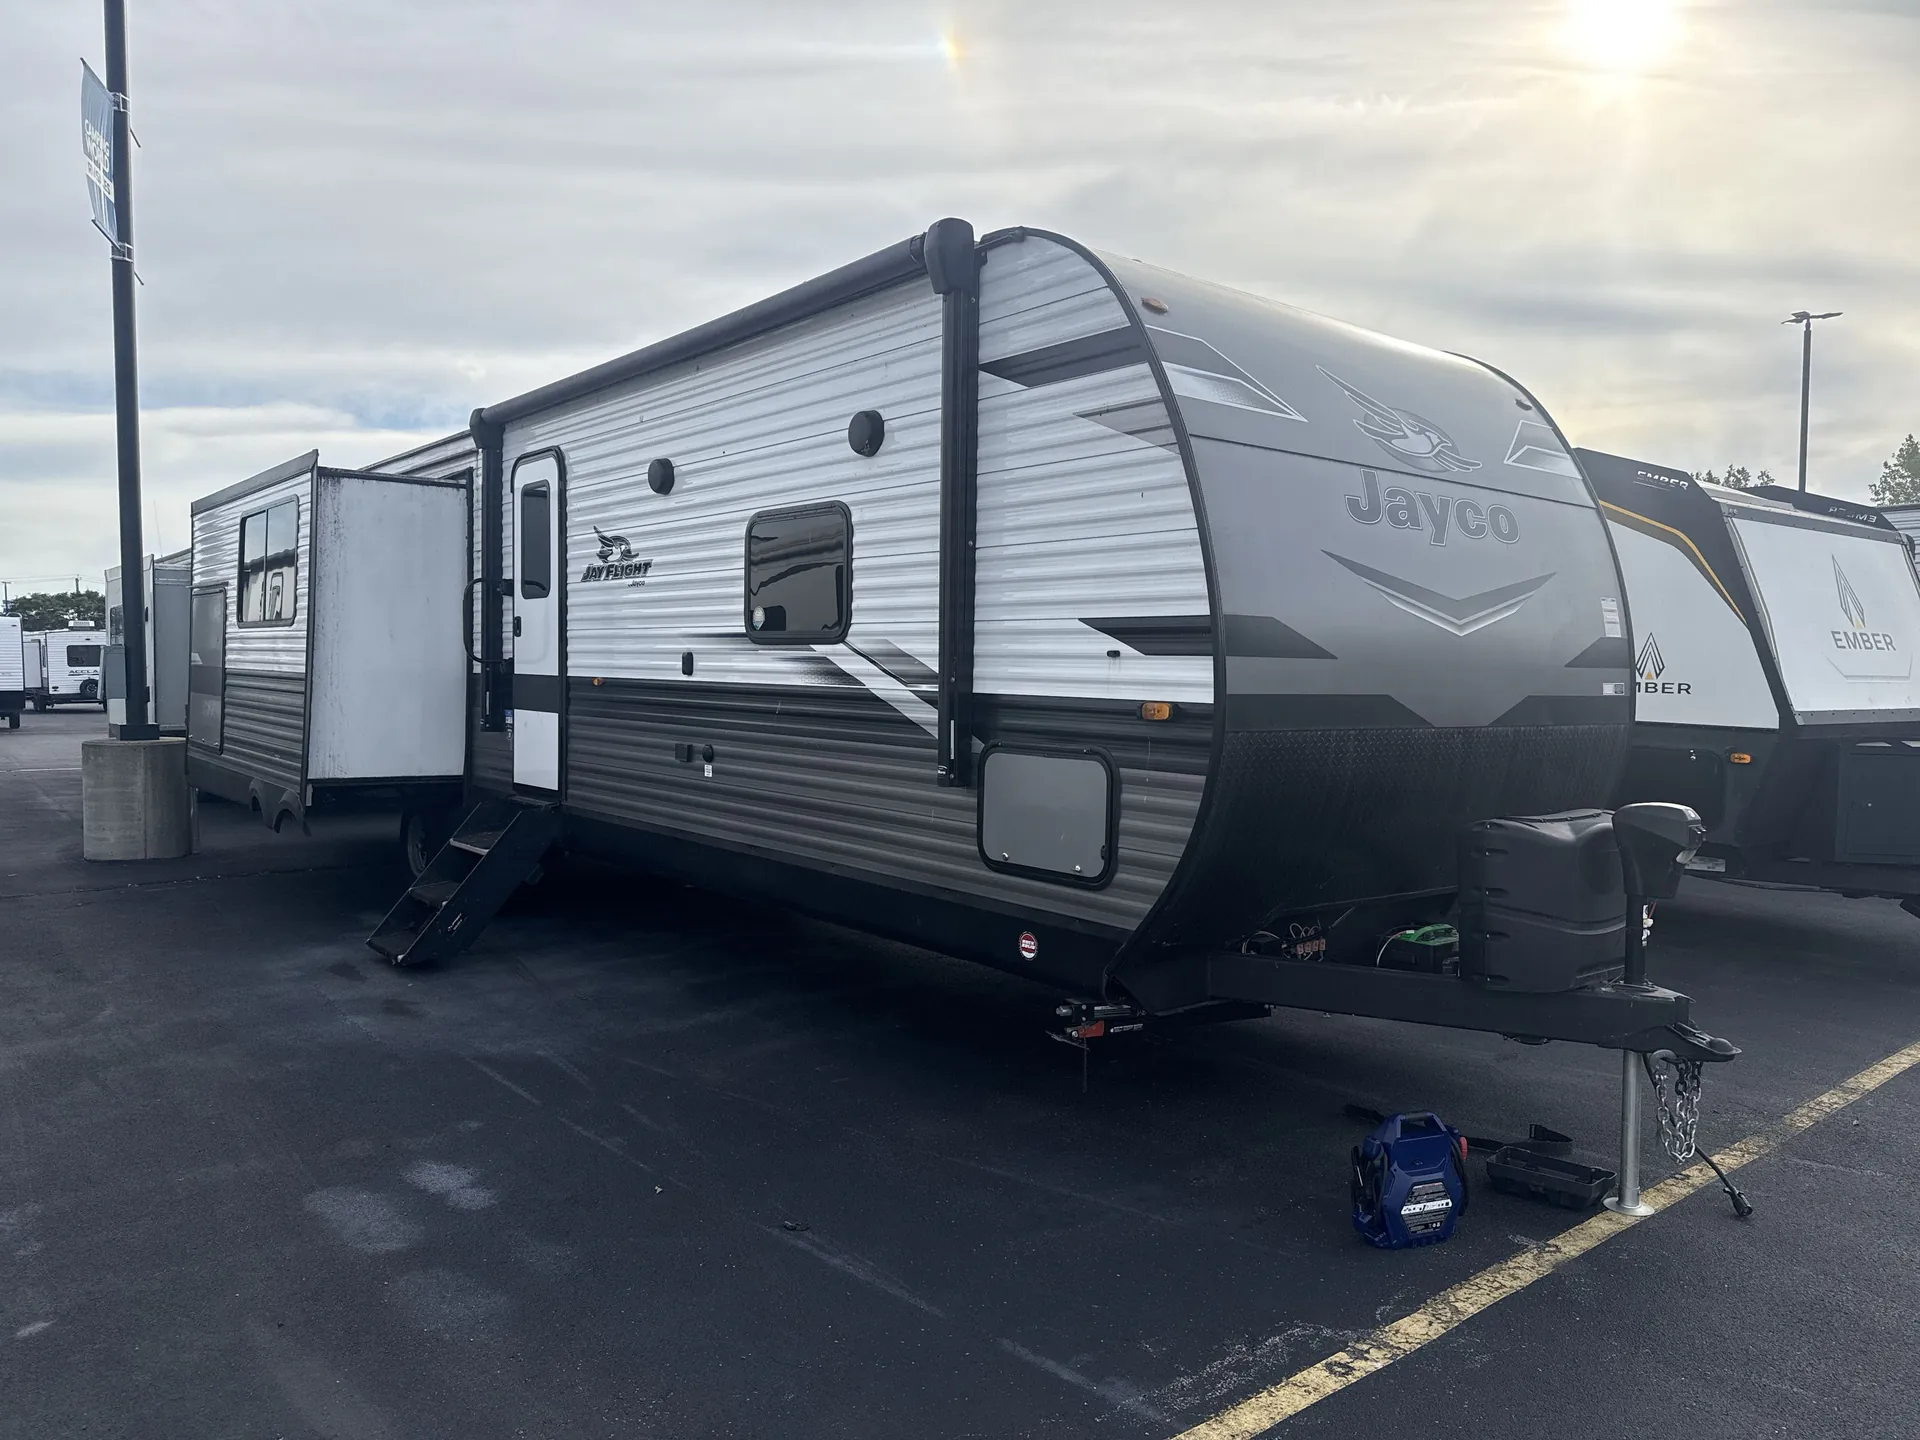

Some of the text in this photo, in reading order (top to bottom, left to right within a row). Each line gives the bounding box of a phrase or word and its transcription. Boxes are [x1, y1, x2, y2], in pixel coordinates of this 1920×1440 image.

[1344, 467, 1520, 547] Jayco
[581, 559, 653, 582] JAY FLIGHT
[1830, 630, 1897, 652] EMBER
